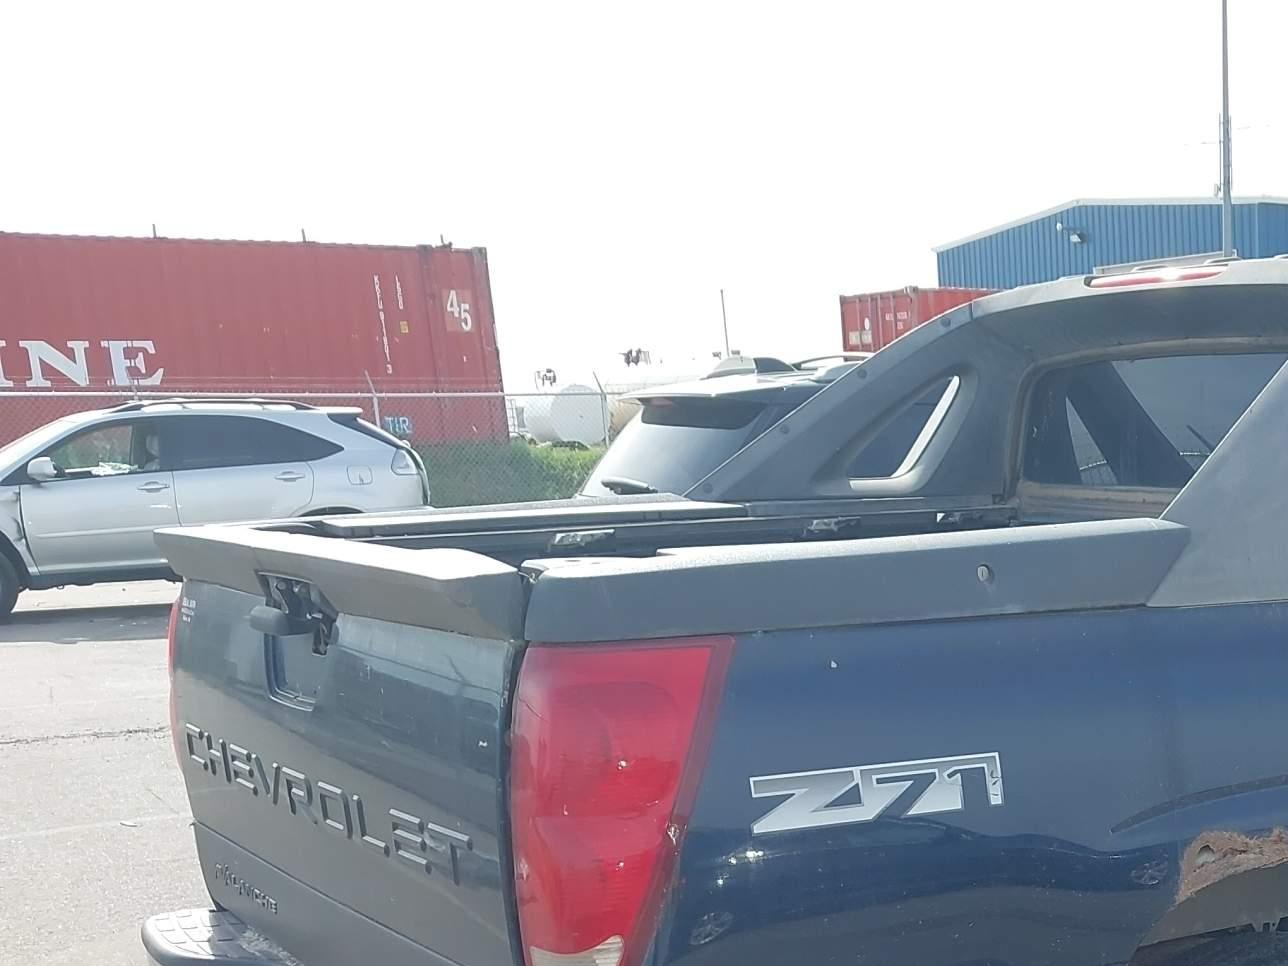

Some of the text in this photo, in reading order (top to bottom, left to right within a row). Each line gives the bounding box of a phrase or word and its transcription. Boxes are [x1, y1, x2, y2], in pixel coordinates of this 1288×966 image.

[446, 289, 473, 332] 45
[184, 722, 474, 887] CHEVROLET
[749, 751, 1004, 836] Z71
